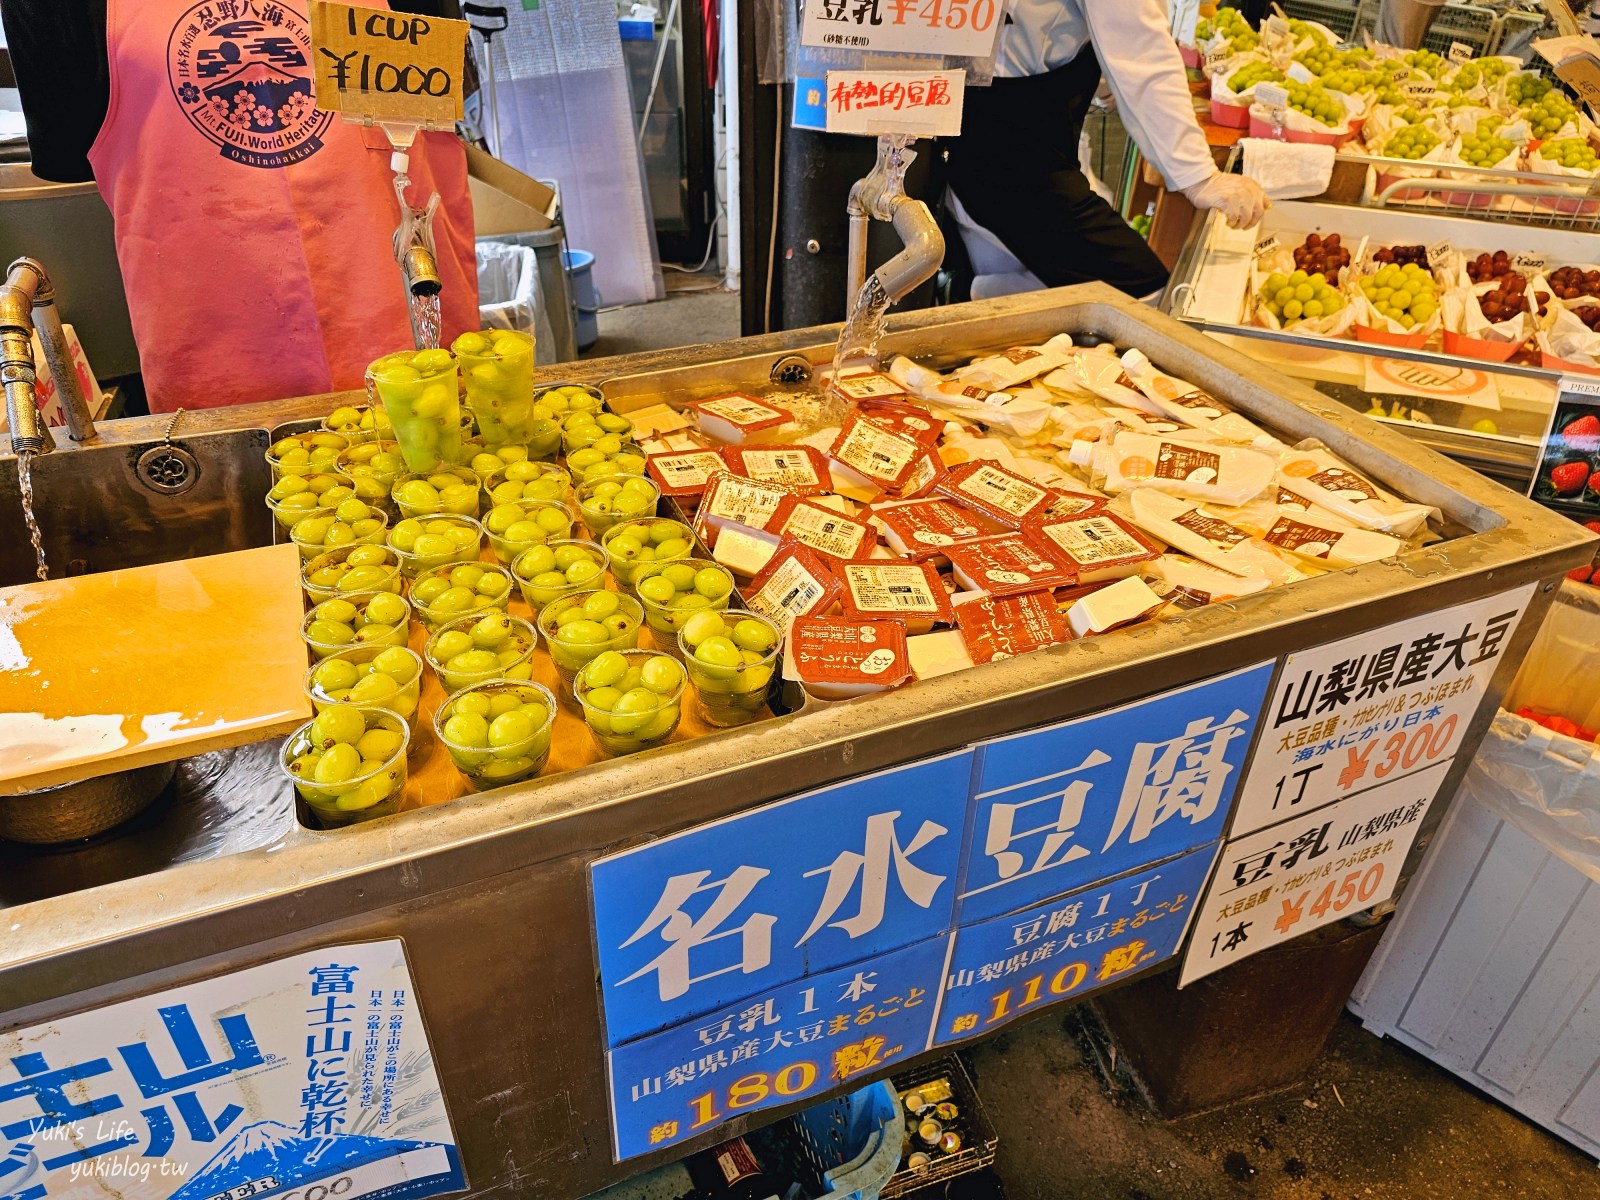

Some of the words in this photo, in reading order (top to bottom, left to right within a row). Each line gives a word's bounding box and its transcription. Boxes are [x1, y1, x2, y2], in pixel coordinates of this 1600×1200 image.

[194, 0, 285, 31] 忍野八海
[365, 14, 430, 45] CUP
[816, 0, 883, 26] 豆乳
[886, 0, 995, 32] ¥450
[319, 47, 451, 97] ¥1000
[831, 75, 951, 114] 有熱的豆腐
[231, 142, 315, 167] Oshinohakkai
[1273, 609, 1519, 730] 山梨県産大豆
[1291, 705, 1445, 765] 海水にがり日本
[1337, 713, 1458, 791] ¥300
[1219, 821, 1334, 896] 豆乳
[1337, 798, 1427, 851] 山梨県産
[1210, 921, 1253, 959] 1本
[1273, 862, 1385, 935] ¥450
